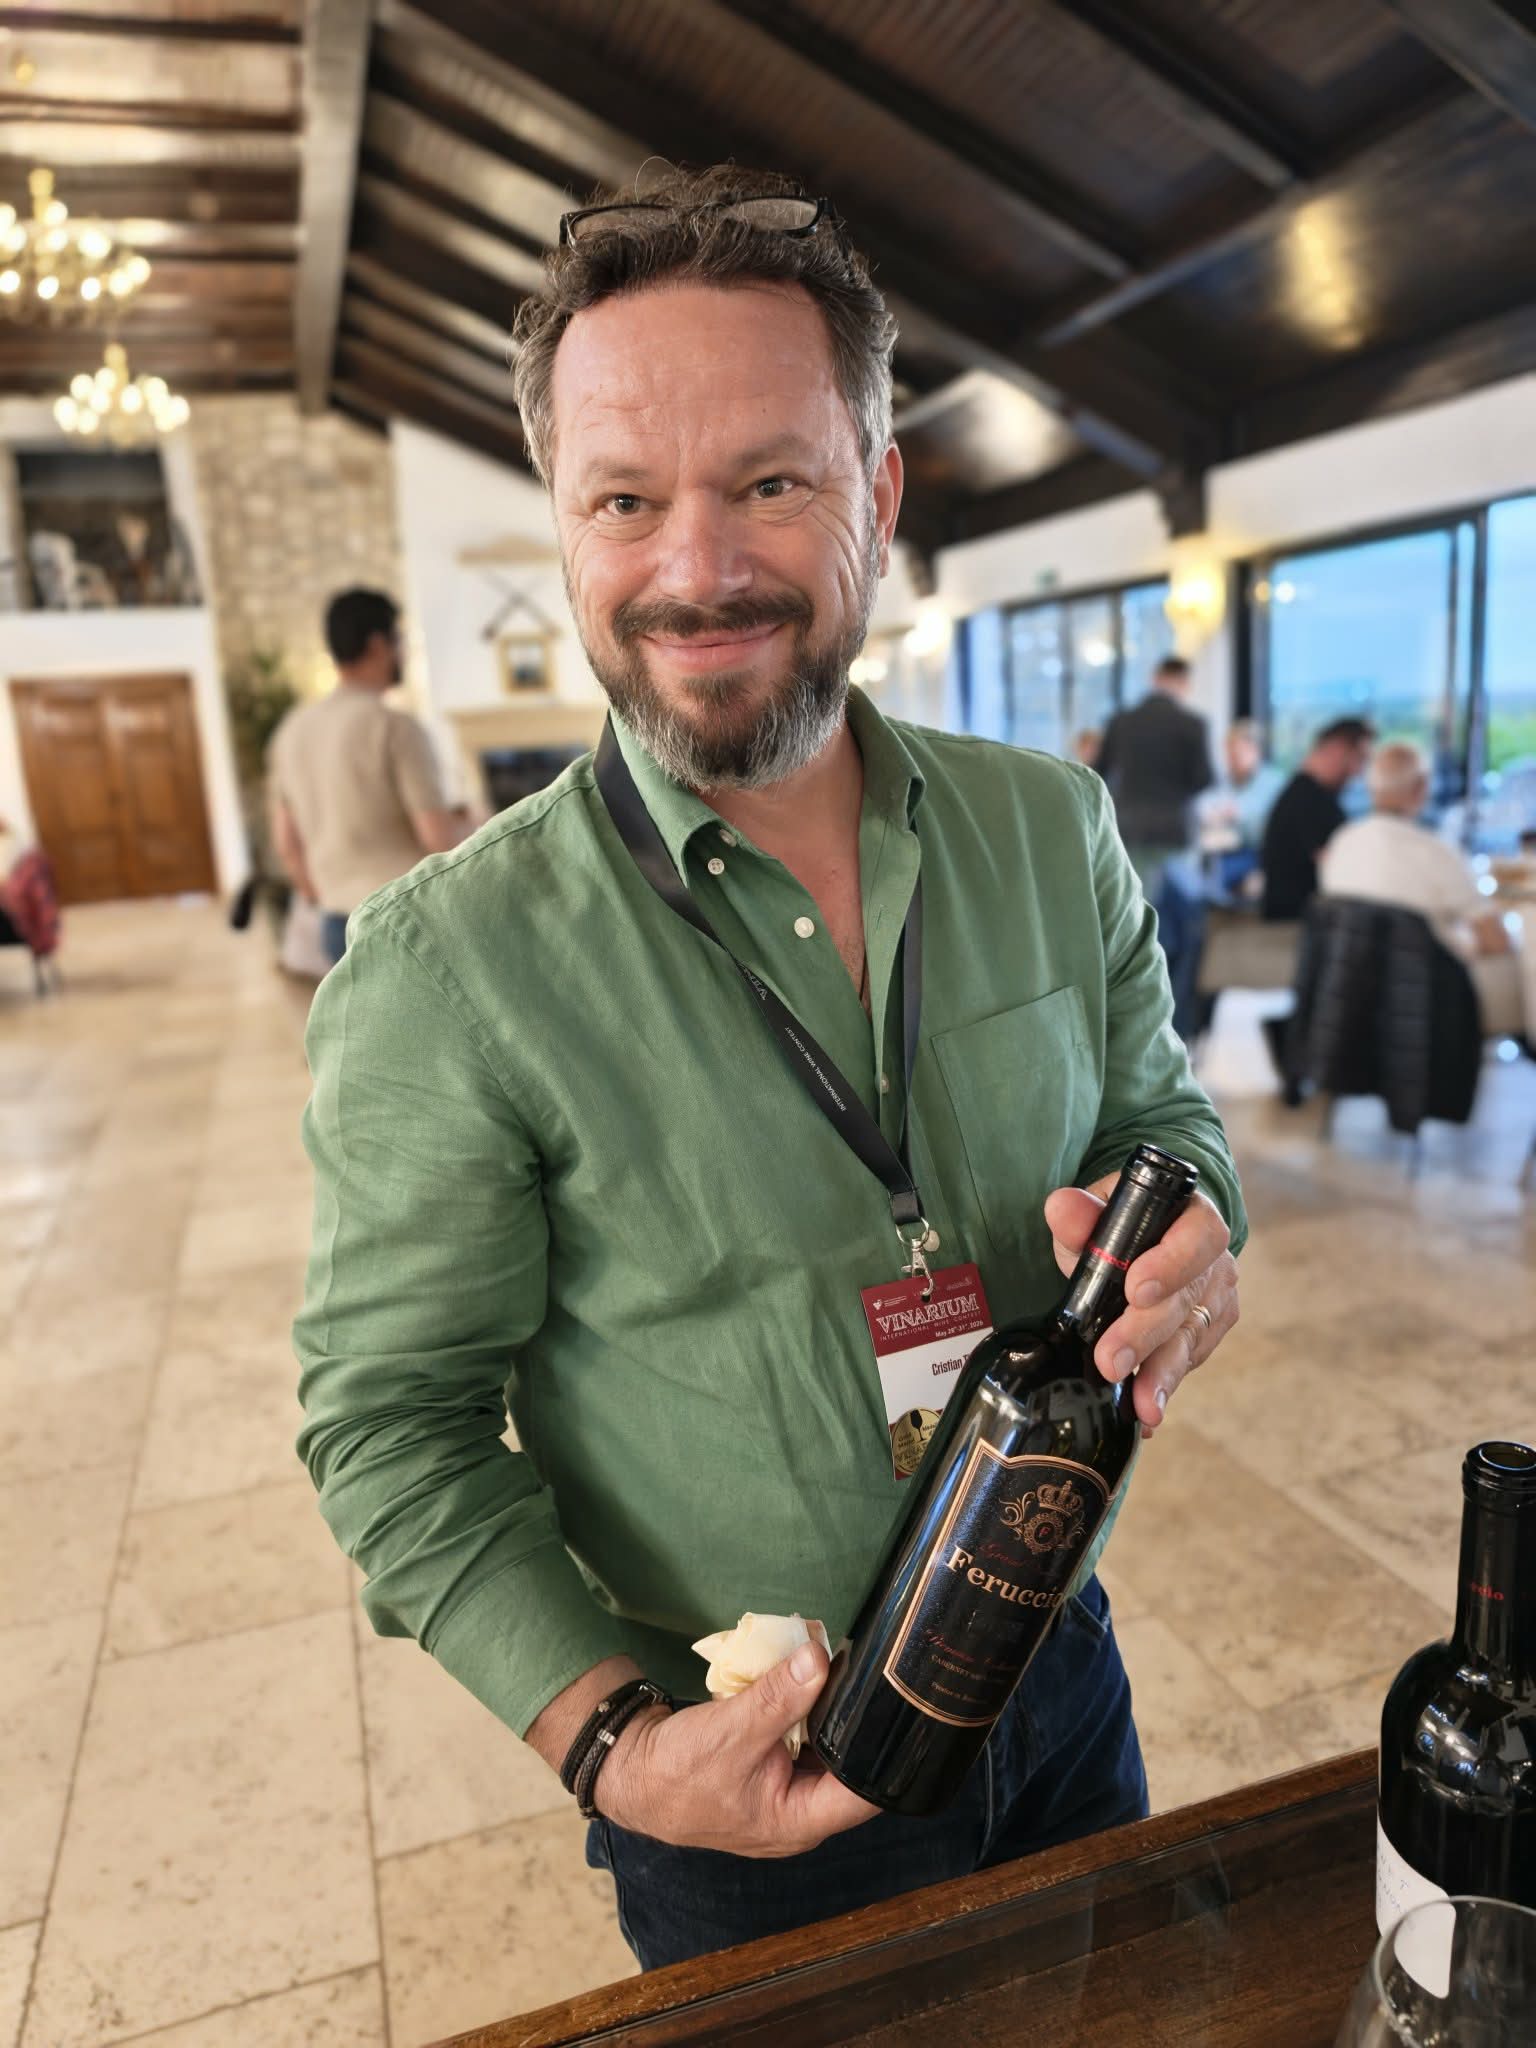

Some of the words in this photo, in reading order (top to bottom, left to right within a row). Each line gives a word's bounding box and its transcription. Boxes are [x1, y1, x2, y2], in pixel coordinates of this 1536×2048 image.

[784, 1026, 806, 1052] CONTEST
[803, 1051, 816, 1068] WINE
[814, 1066, 847, 1112] INTERNATIONAL
[875, 1293, 980, 1334] VINARIUM
[880, 1325, 929, 1342] INTERNATIONAL
[933, 1319, 949, 1328] WINE
[954, 1310, 981, 1322] CONTEST
[935, 1330, 947, 1338] May
[931, 1357, 963, 1376] Cristian
